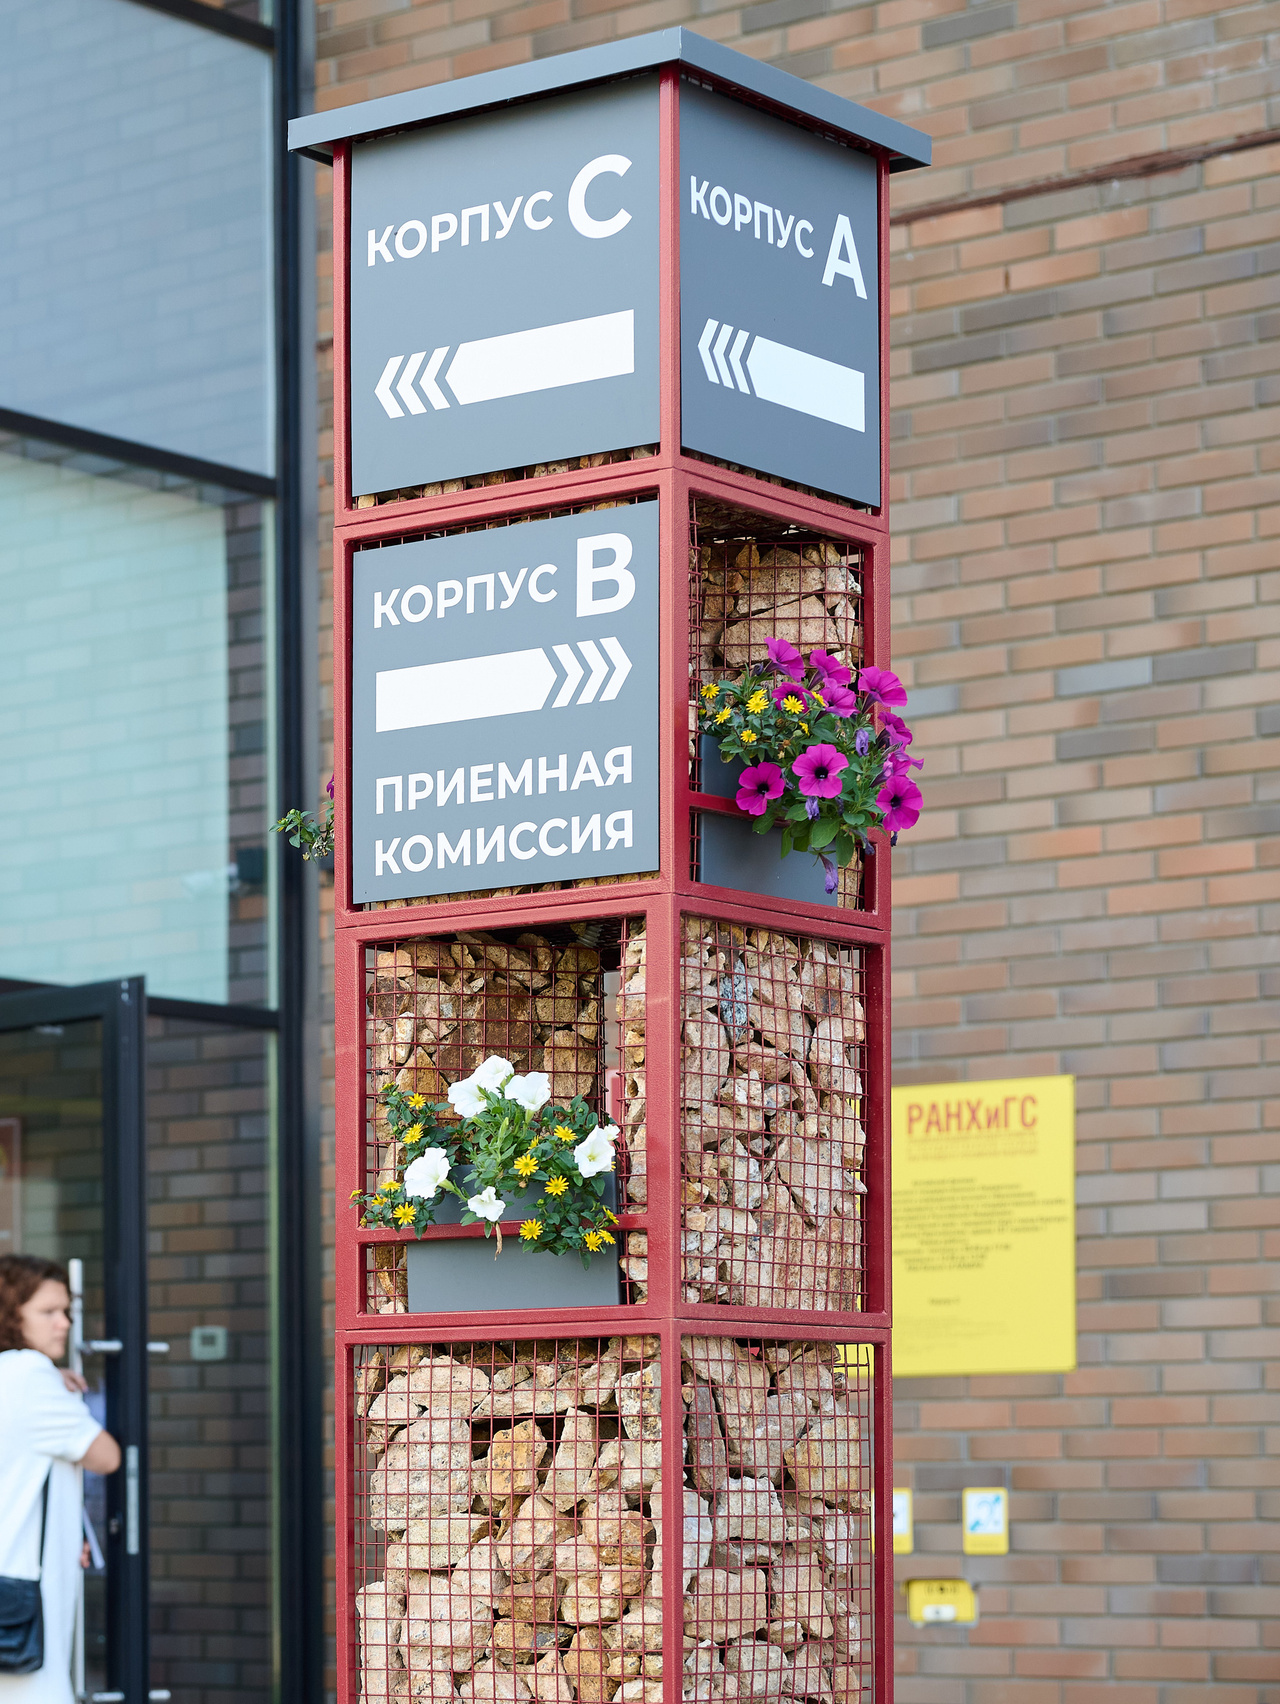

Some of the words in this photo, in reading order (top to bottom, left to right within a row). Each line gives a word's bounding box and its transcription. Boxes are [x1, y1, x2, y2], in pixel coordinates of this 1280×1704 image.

[368, 191, 553, 267] КОРПУС
[690, 175, 815, 258] КОРПУС
[373, 563, 558, 629] КОРПУС
[375, 745, 633, 815] ПРИЕМНАЯ
[375, 809, 634, 877] КОМИССИЯ
[907, 1095, 1037, 1135] РАНХиГС
